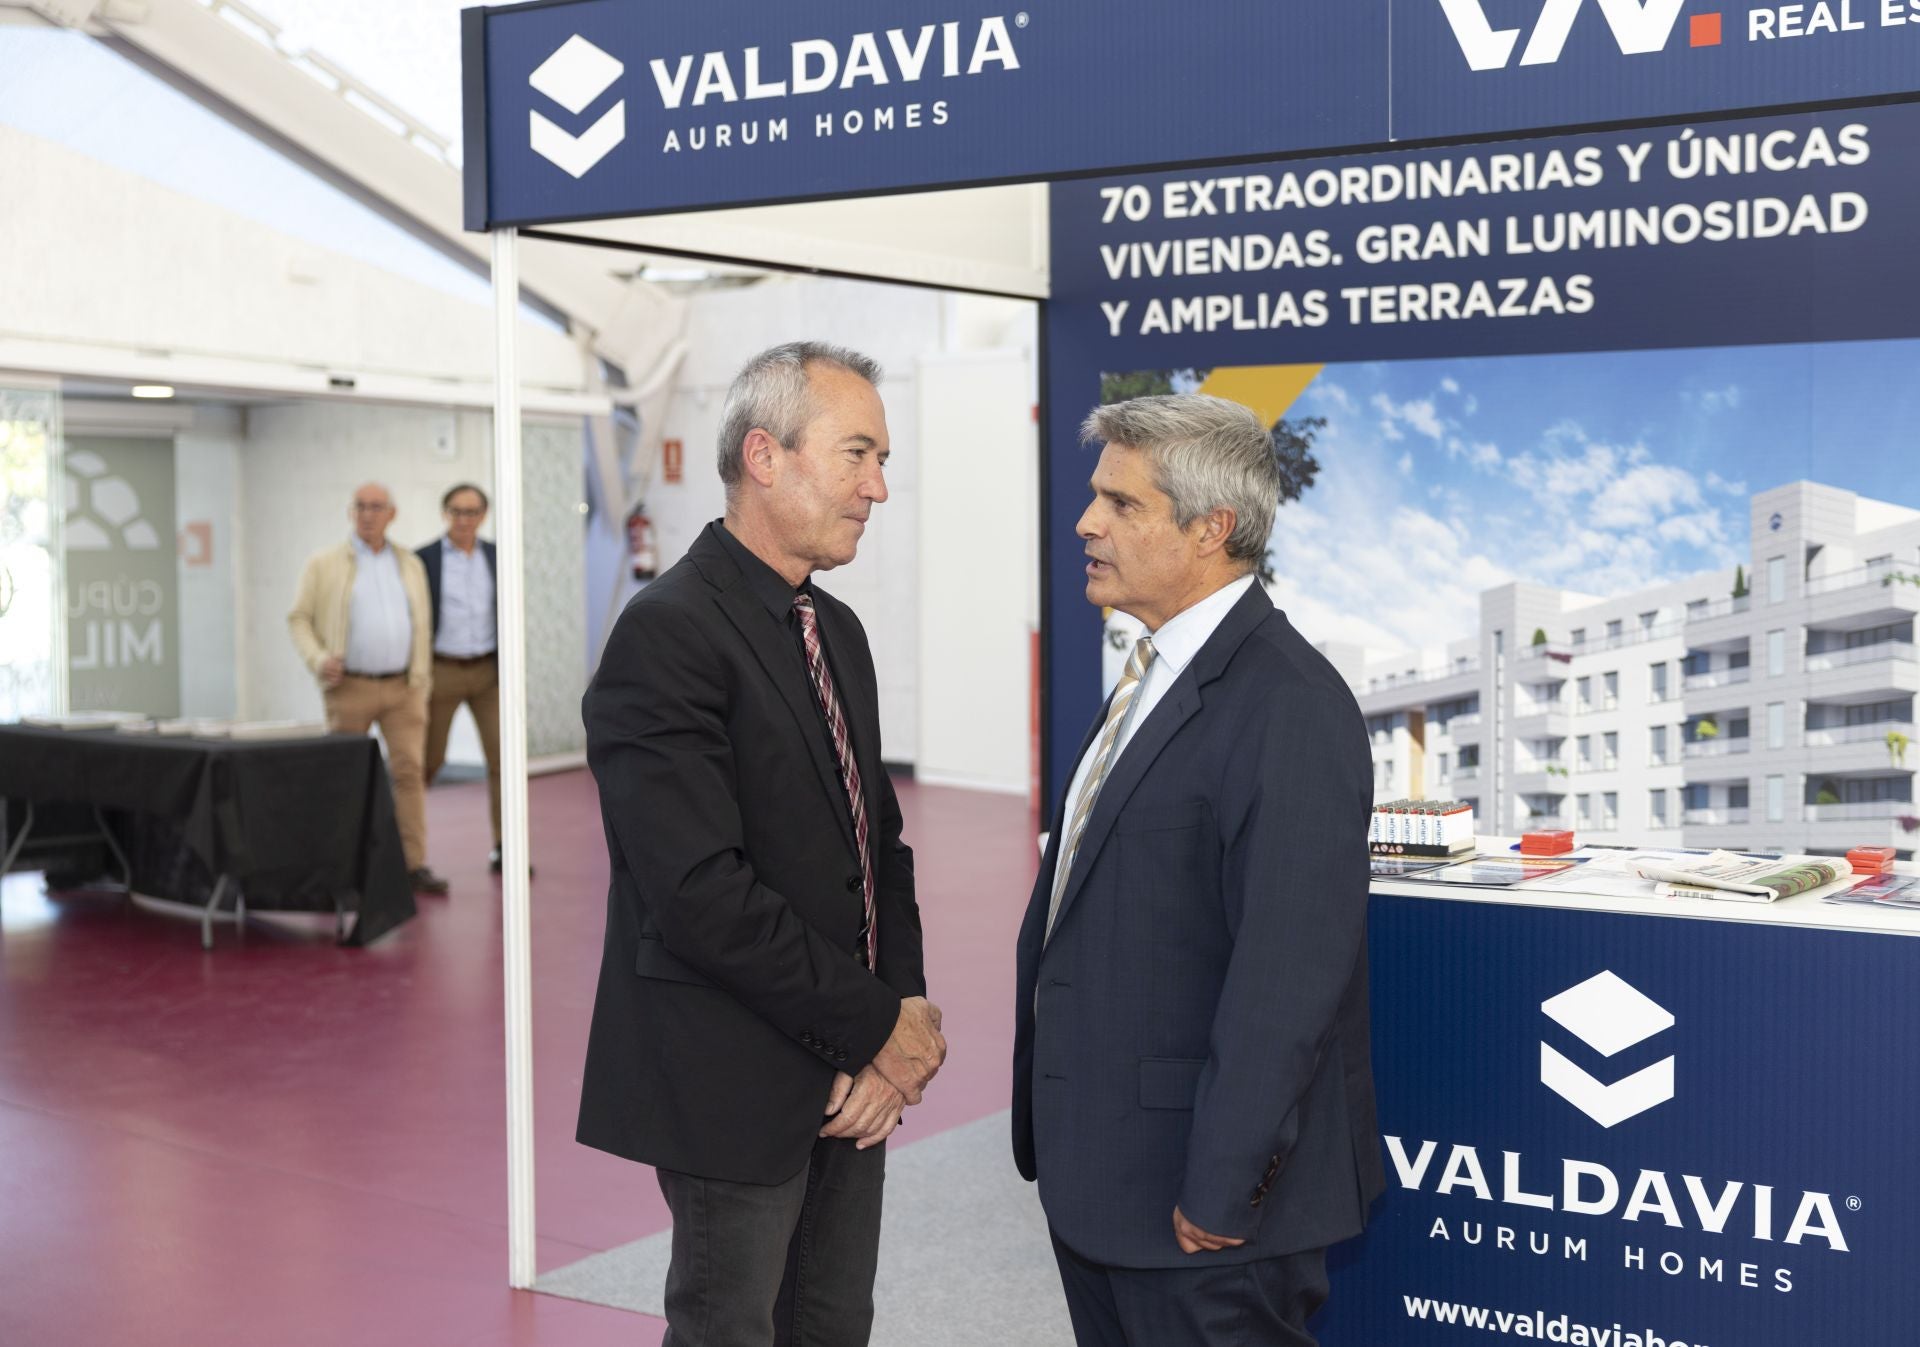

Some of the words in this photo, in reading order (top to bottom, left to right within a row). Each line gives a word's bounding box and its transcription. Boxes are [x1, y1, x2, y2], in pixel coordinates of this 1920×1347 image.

[1748, 0, 1865, 42] REAL
[663, 117, 788, 153] AURUM
[815, 100, 949, 138] HOMES
[1100, 184, 1151, 224] 70
[1163, 146, 1603, 219] EXTRAORDINARIAS
[1616, 142, 1652, 183] Y
[1667, 123, 1870, 179] ÚNICAS
[1100, 229, 1343, 280] VIVIENDAS.
[1356, 218, 1490, 264] GRAN
[1506, 191, 1868, 255] LUMINOSIDAD
[1101, 301, 1129, 336] Y
[1140, 289, 1329, 335] AMPLIAS
[1340, 274, 1594, 325] TERRAZAS
[1429, 1217, 1587, 1261] AURUM
[1624, 1245, 1793, 1293] HOMES
[1403, 1295, 1710, 1347] www.valdaviah
